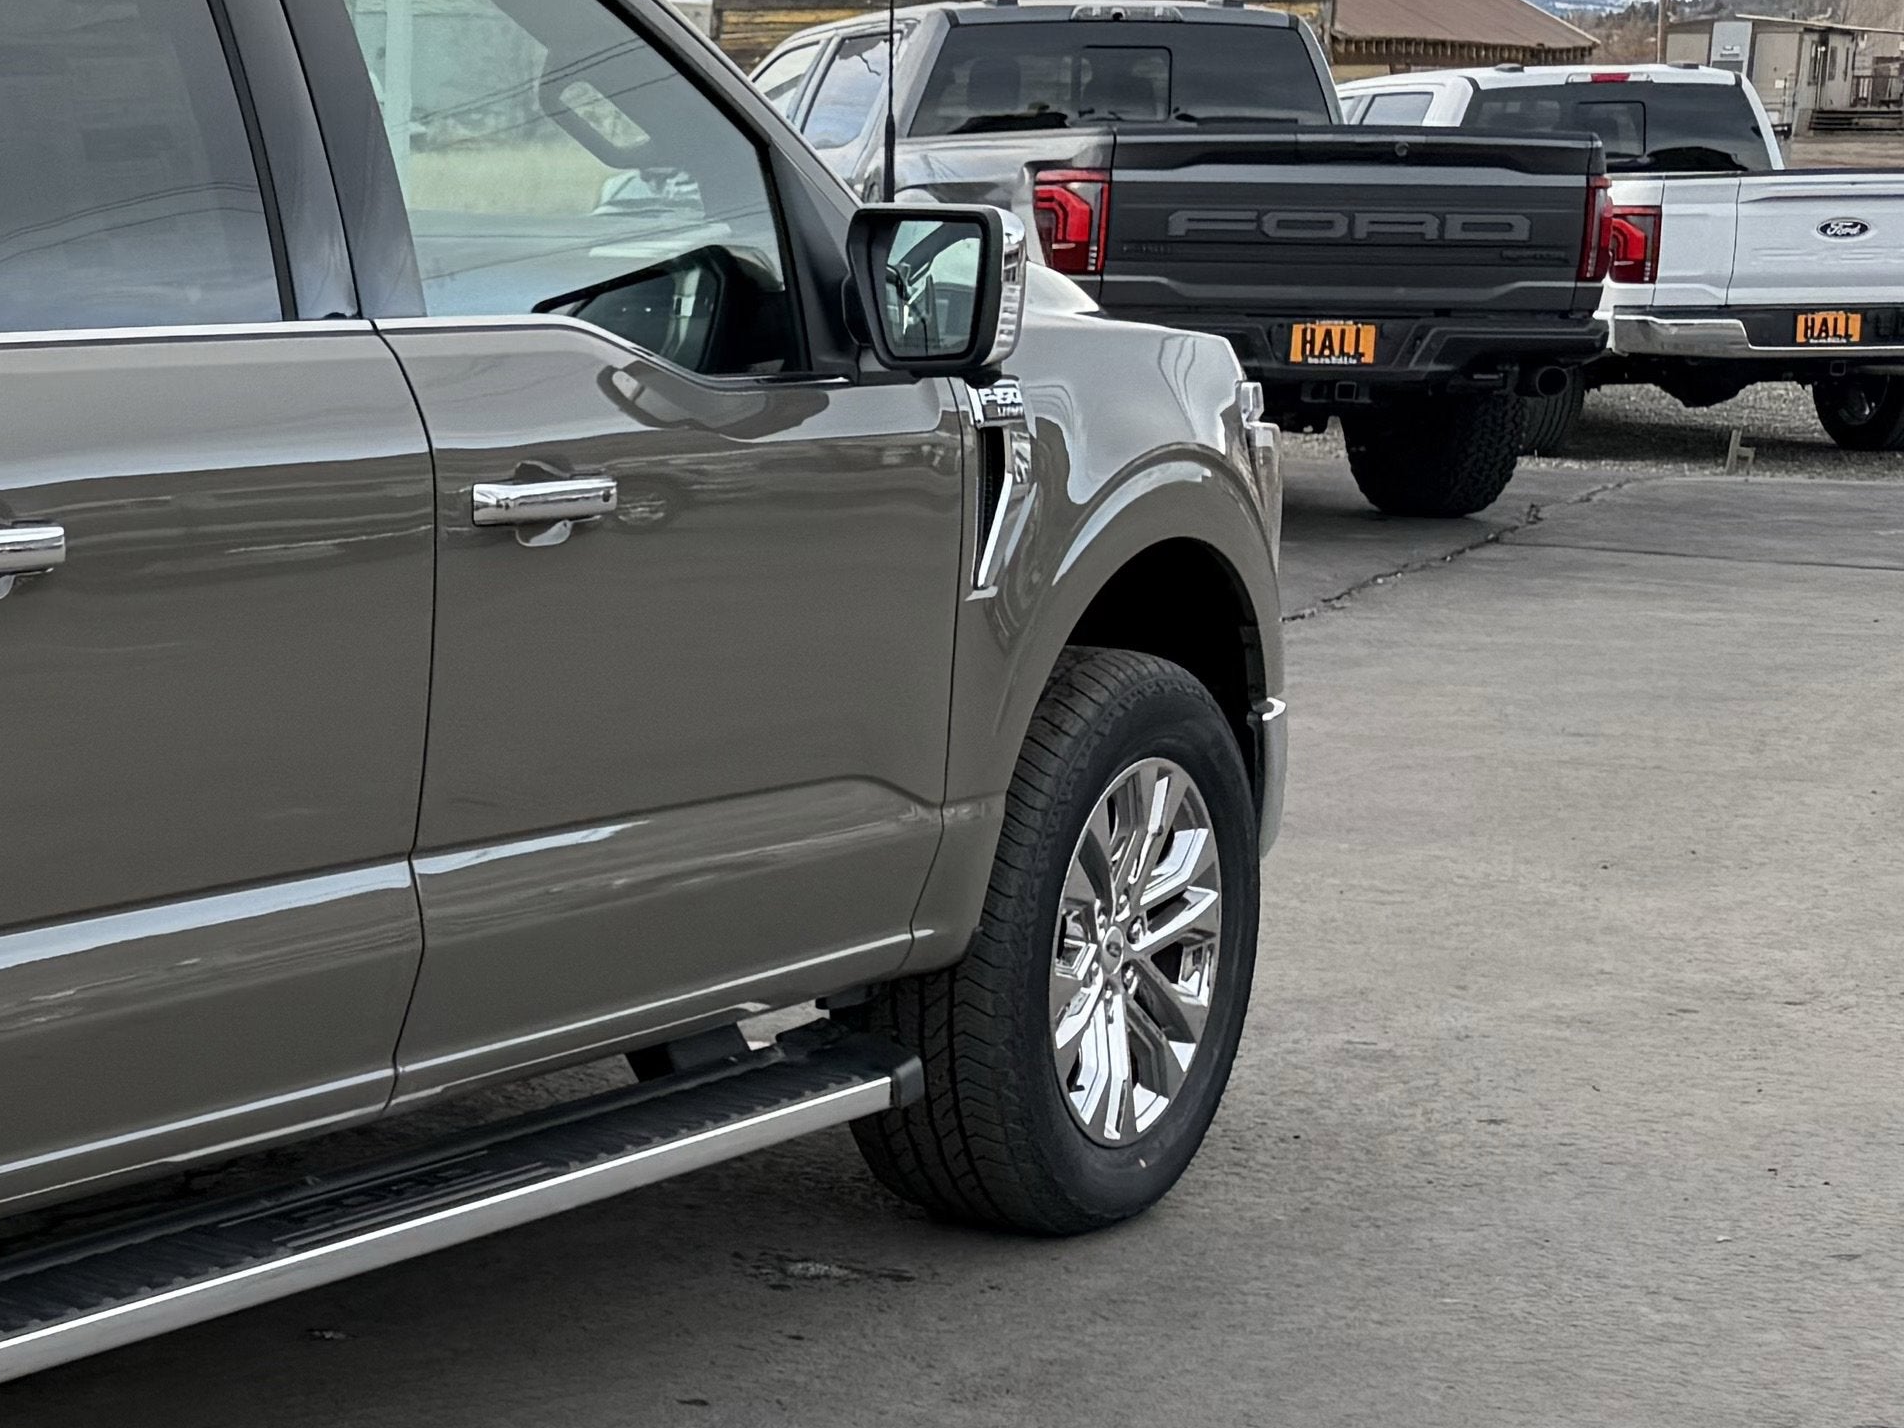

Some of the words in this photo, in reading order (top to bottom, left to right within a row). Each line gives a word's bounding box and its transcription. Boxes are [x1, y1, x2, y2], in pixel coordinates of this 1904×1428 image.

[1166, 209, 1533, 242] FORD
[1825, 222, 1862, 237] Ford
[1803, 316, 1854, 339] HALL
[1301, 326, 1366, 358] HALL
